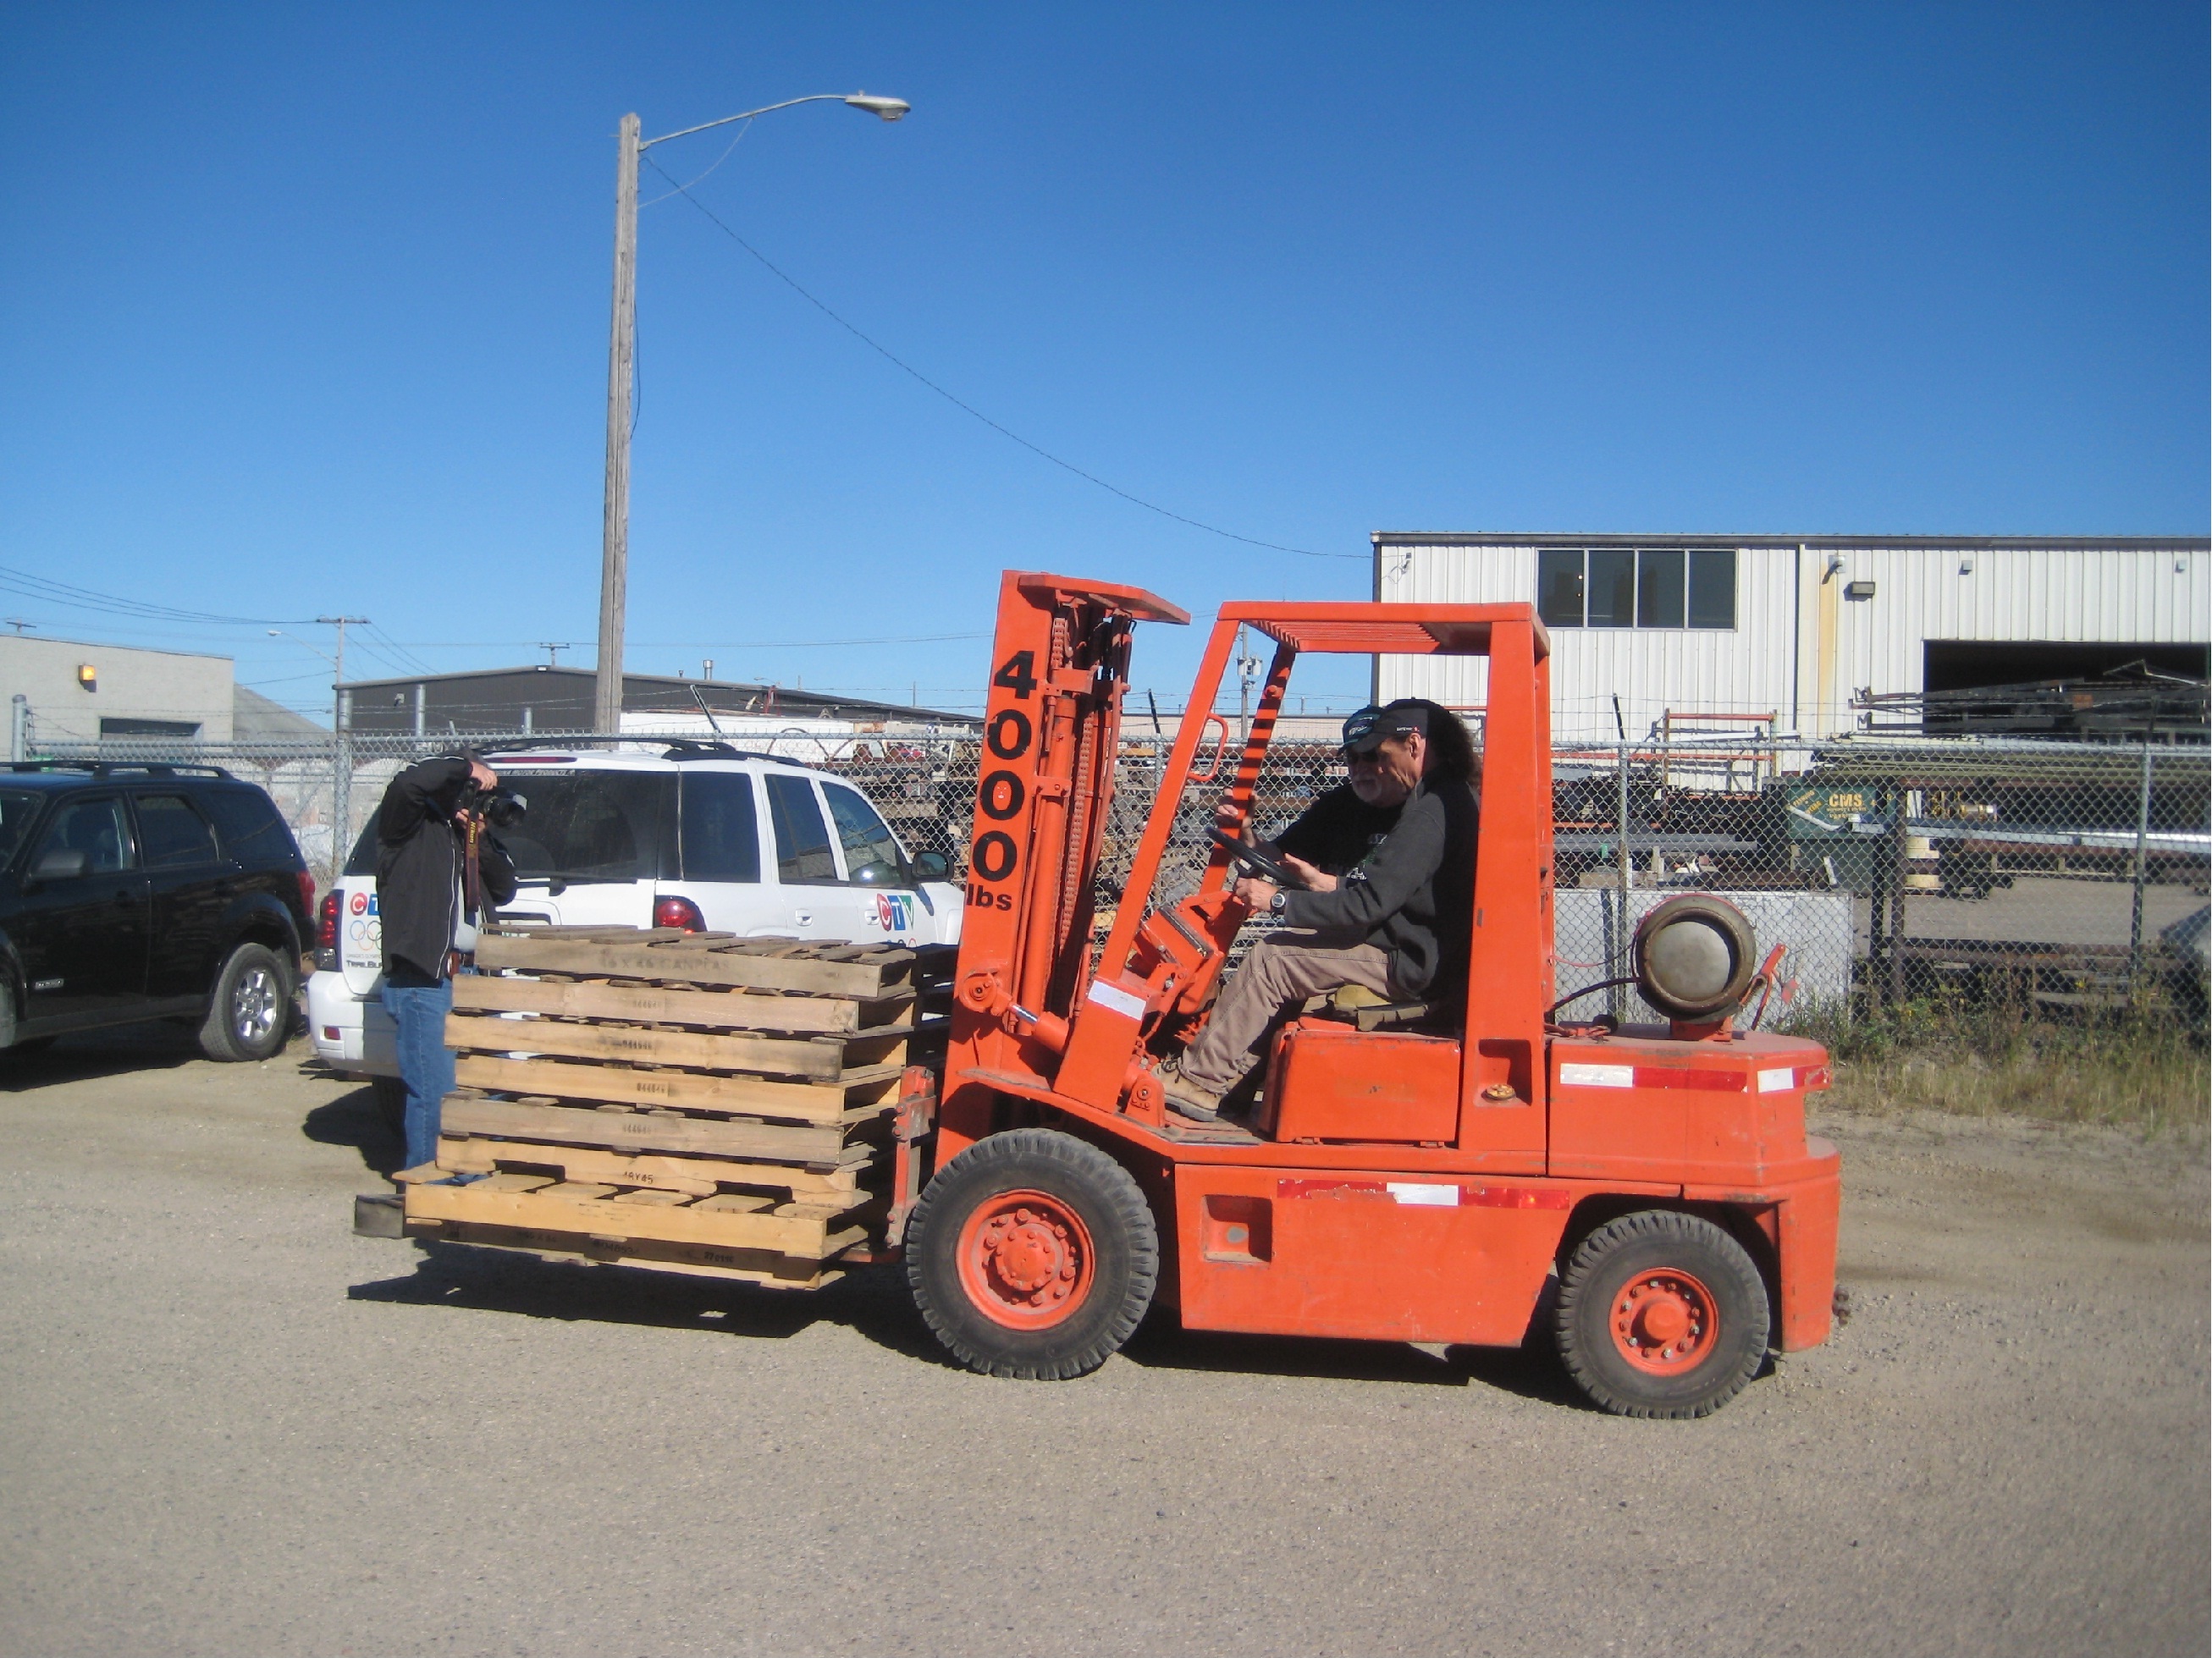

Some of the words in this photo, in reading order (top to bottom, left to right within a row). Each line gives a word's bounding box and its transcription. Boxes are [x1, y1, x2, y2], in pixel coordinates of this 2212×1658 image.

[974, 650, 1038, 882] 4000
[1829, 793, 1862, 807] CMS
[877, 893, 914, 932] CTV
[966, 884, 1012, 912] lbs
